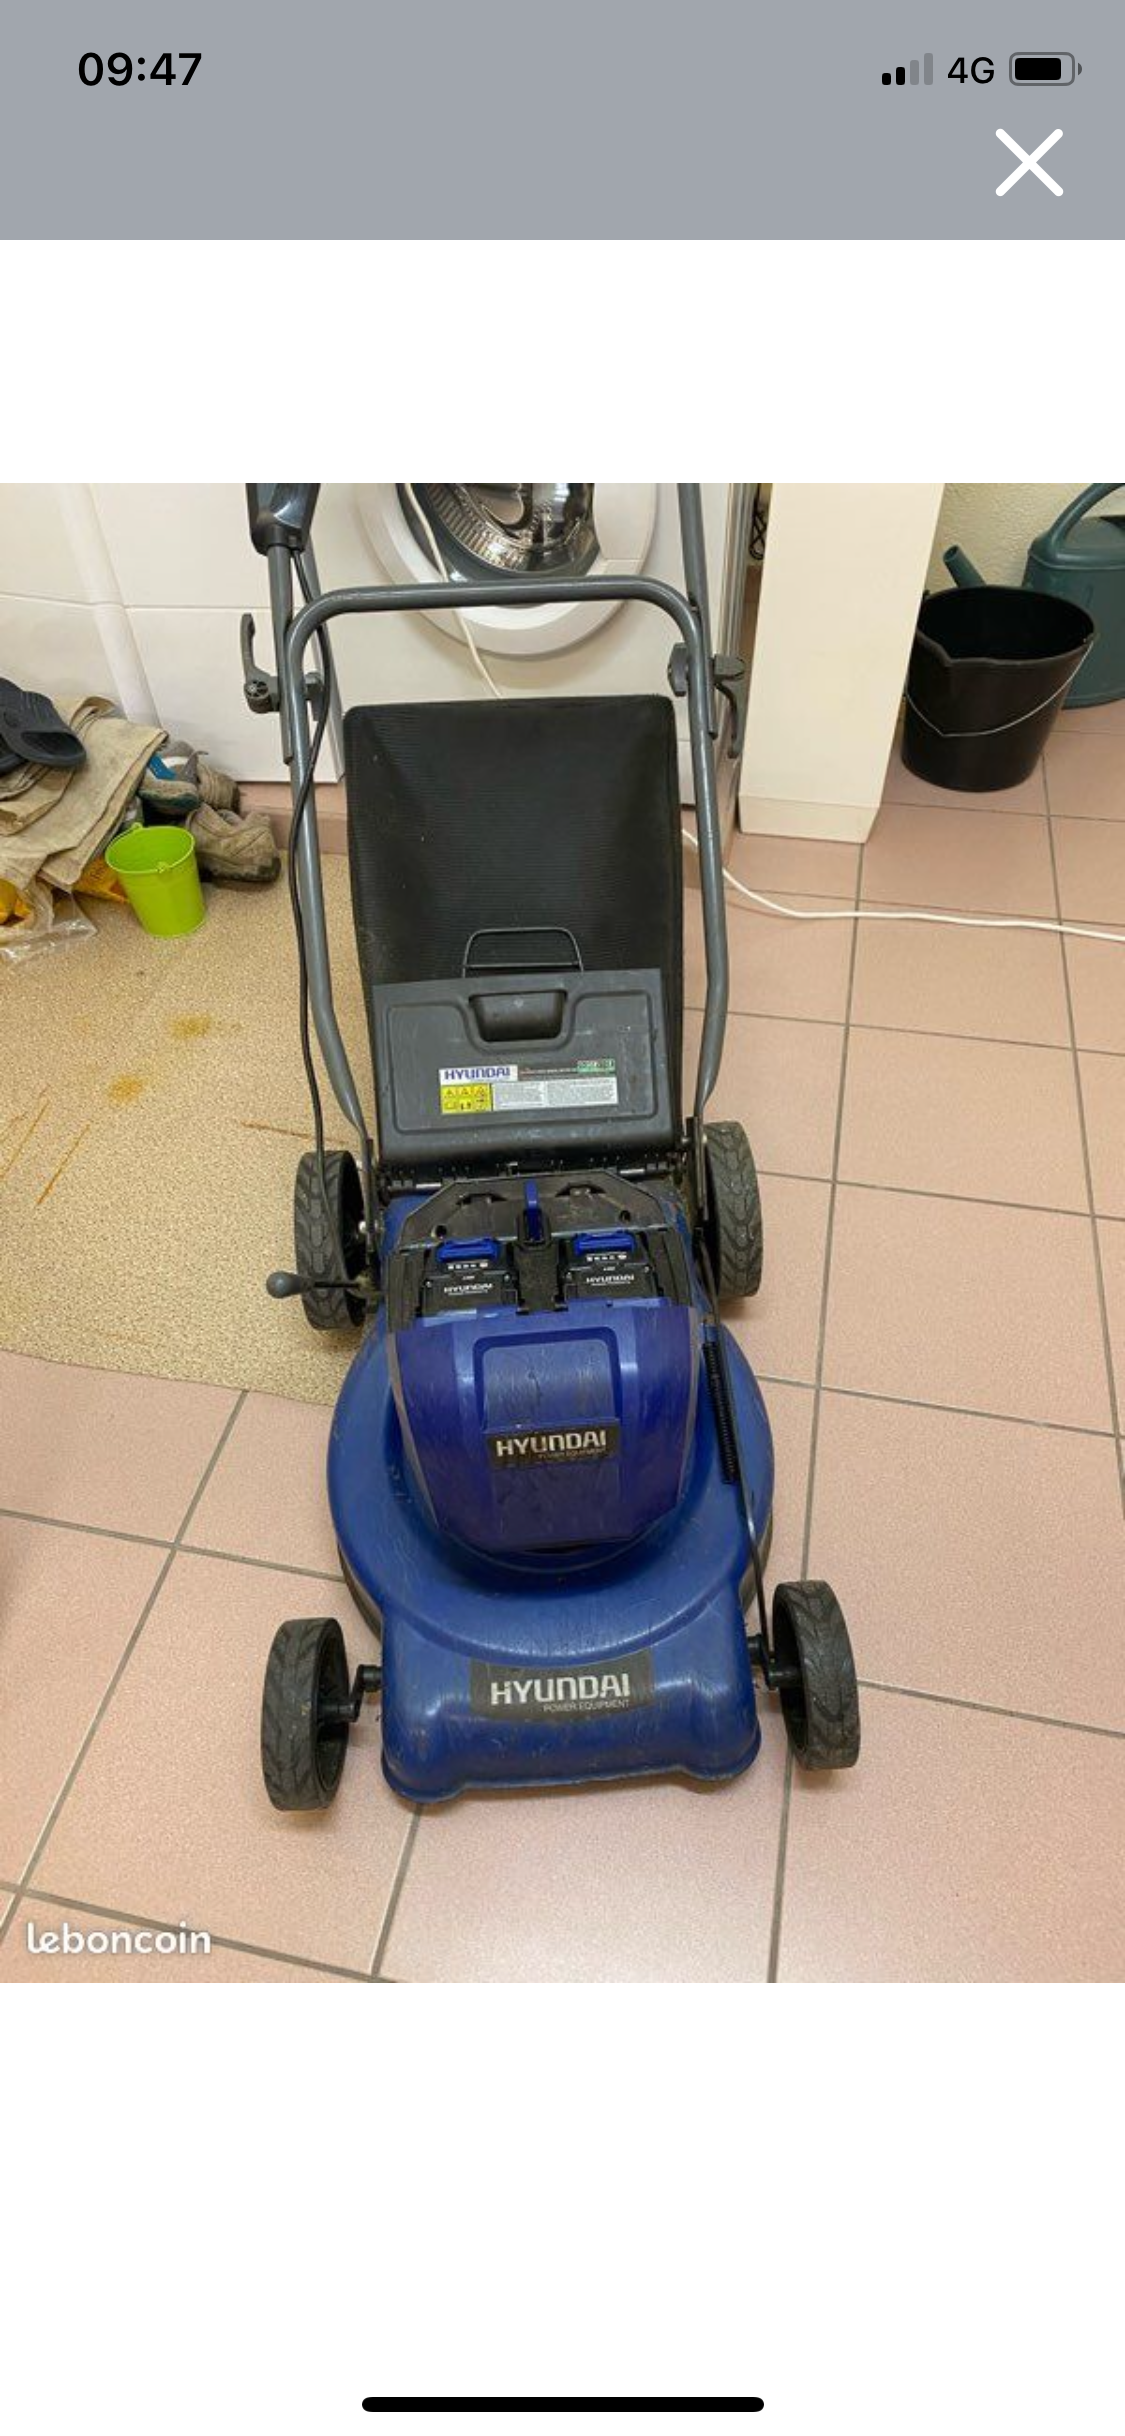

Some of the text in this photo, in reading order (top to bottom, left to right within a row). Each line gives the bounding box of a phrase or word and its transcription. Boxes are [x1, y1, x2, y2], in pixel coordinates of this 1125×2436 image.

[444, 1066, 511, 1080] HYUNDAI
[495, 1430, 607, 1457] HYUNDAI
[490, 1673, 631, 1706] HYUNDAI
[543, 1699, 630, 1713] POWER EQUIPMENT
